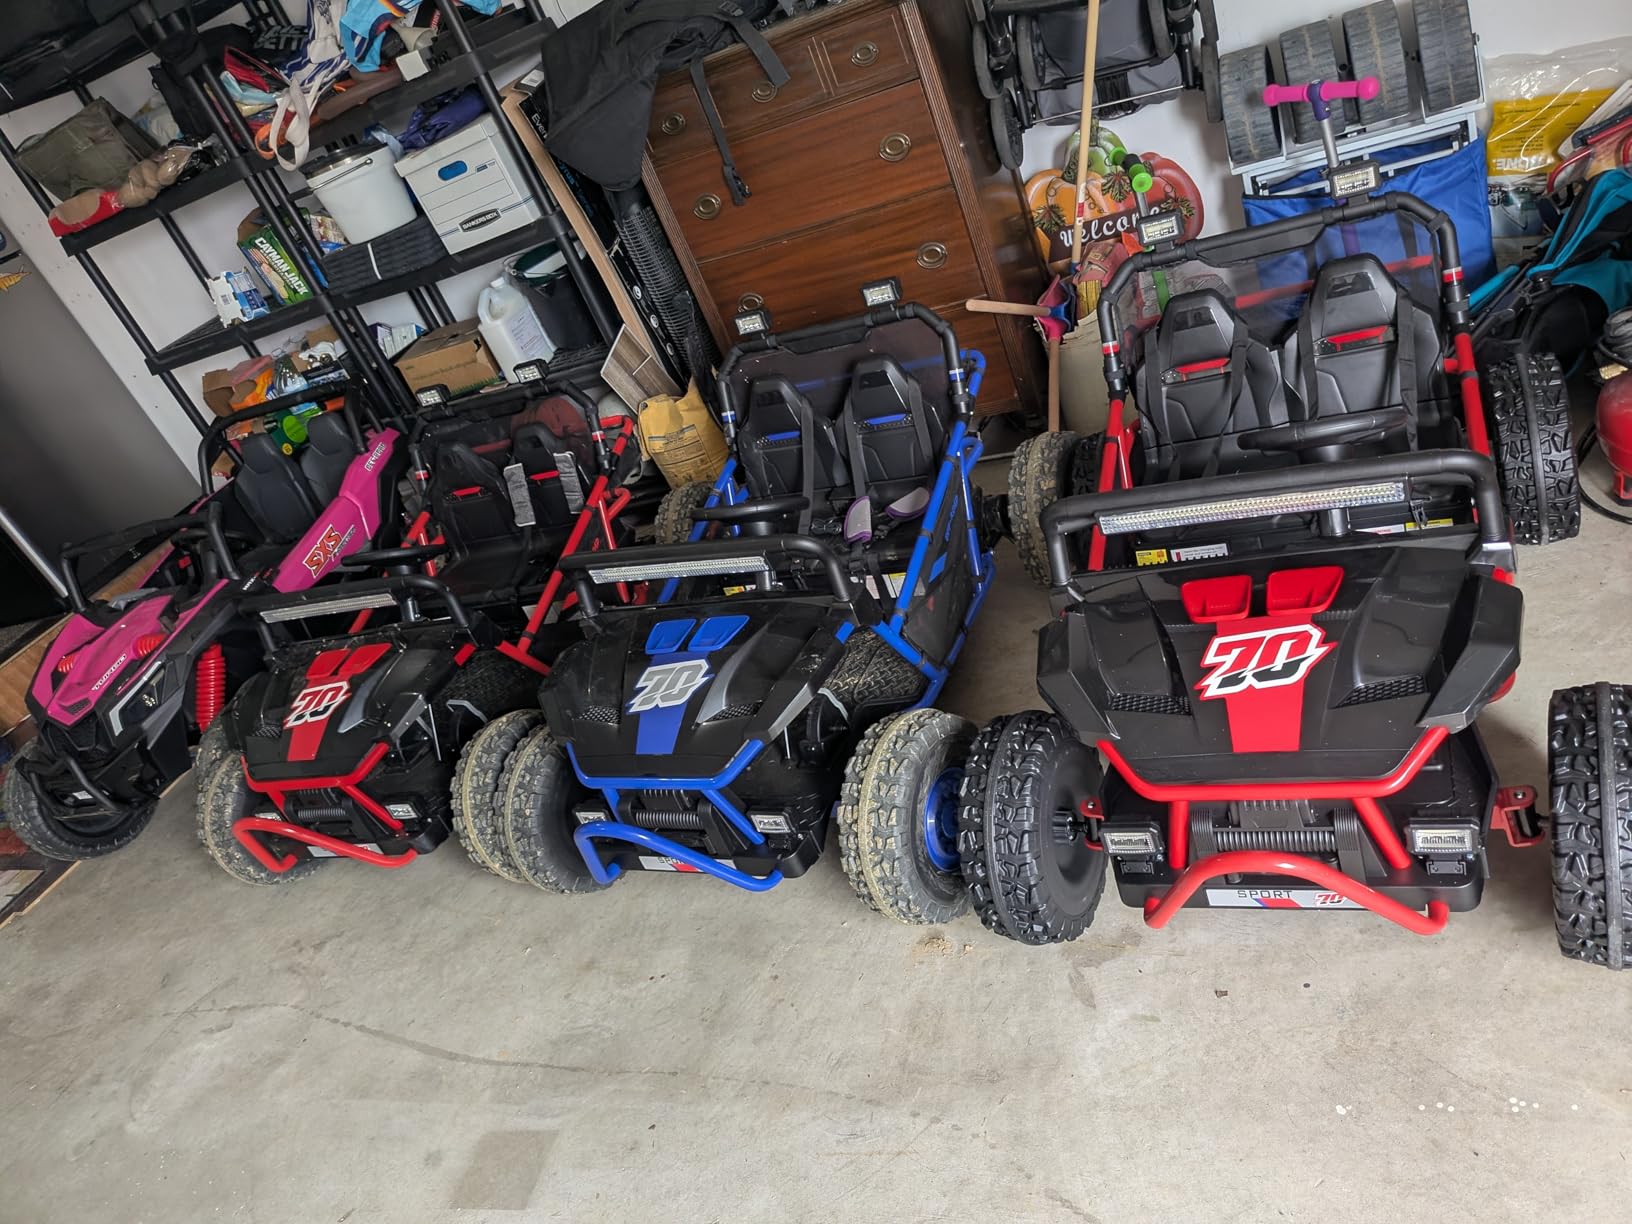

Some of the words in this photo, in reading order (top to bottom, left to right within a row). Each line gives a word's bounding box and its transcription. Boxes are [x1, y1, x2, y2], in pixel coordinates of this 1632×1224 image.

[462, 215, 486, 230] BANKERS
[486, 211, 498, 222] BOX
[254, 236, 290, 275] CAYMAN
[283, 267, 309, 297] JACK
[303, 525, 341, 578] SXS
[627, 659, 710, 714] 70
[1196, 624, 1336, 700] 70
[285, 680, 350, 728] 70
[1237, 890, 1292, 898] SPORT
